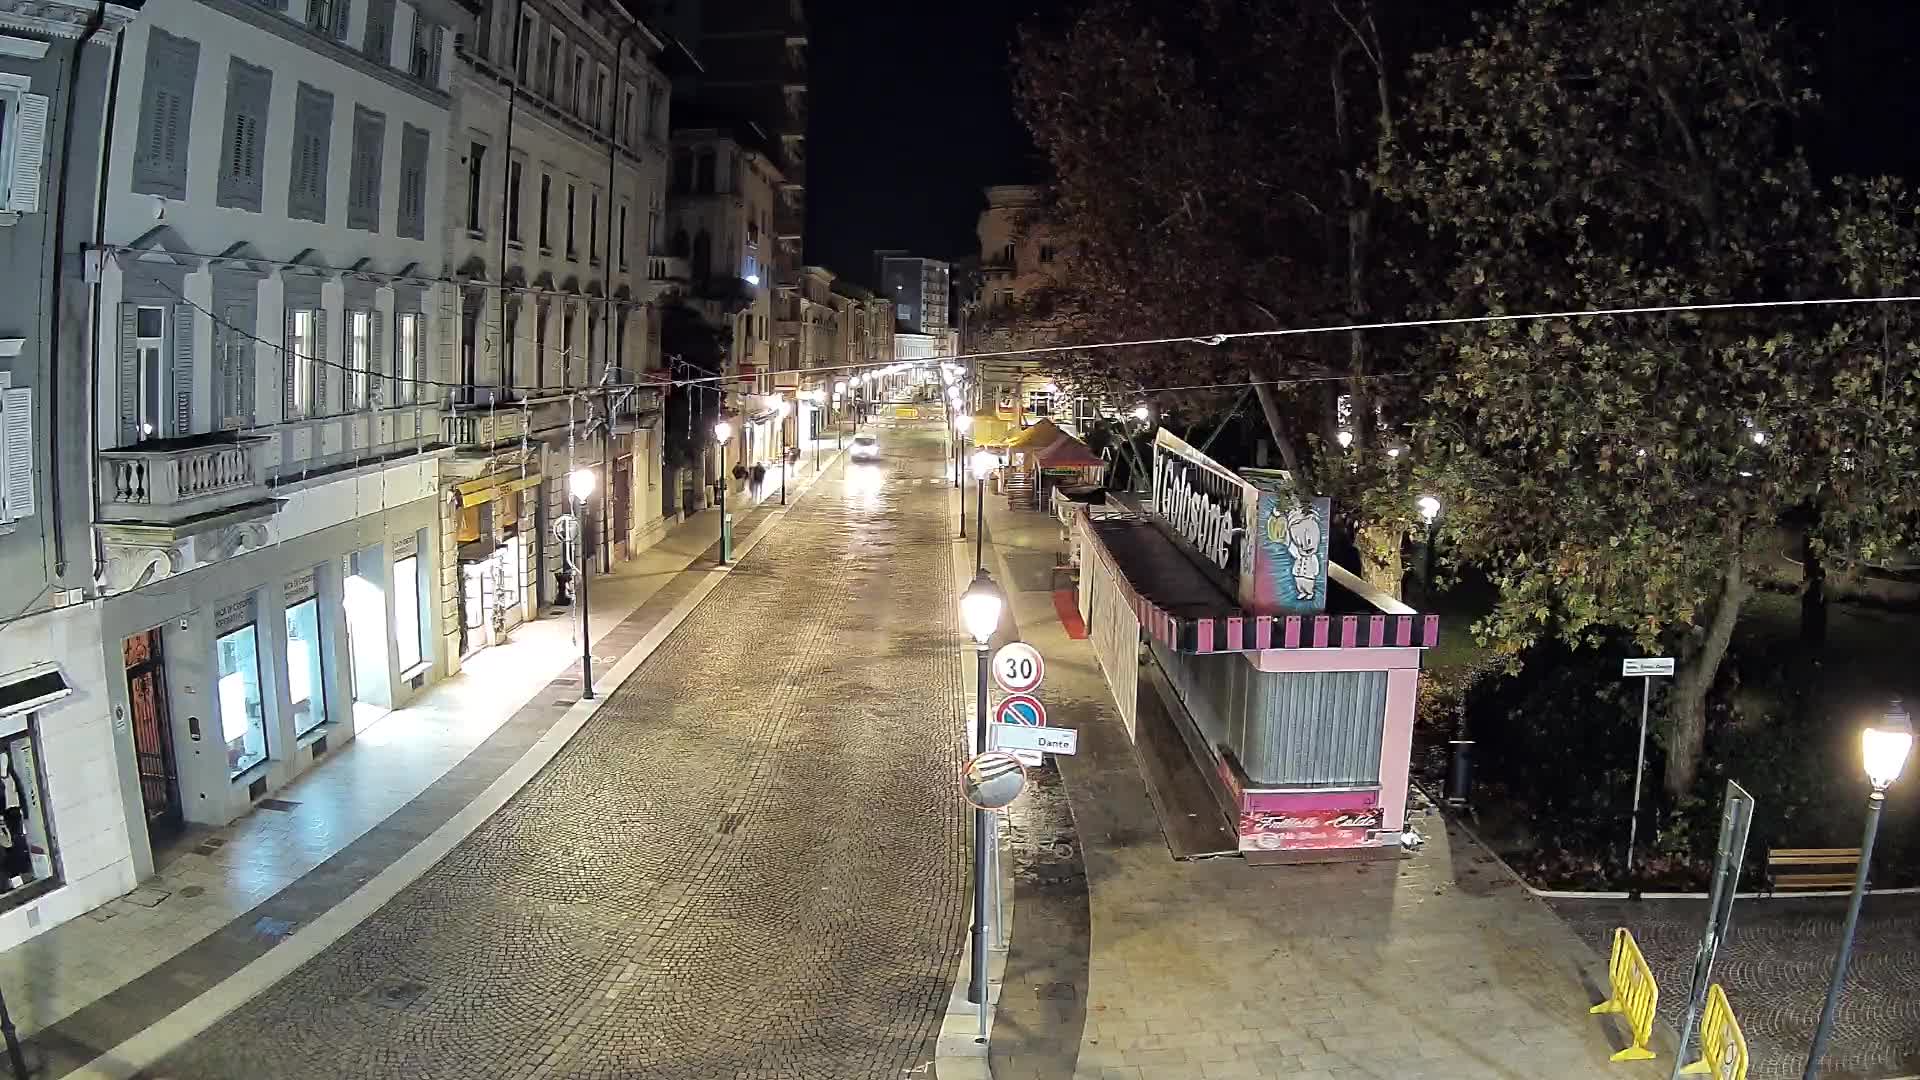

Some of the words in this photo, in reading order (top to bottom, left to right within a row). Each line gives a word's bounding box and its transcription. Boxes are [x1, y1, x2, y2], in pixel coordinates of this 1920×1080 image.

[1162, 459, 1233, 570] Golosone
[1006, 658, 1032, 679] 30
[1038, 737, 1070, 749] Dante
